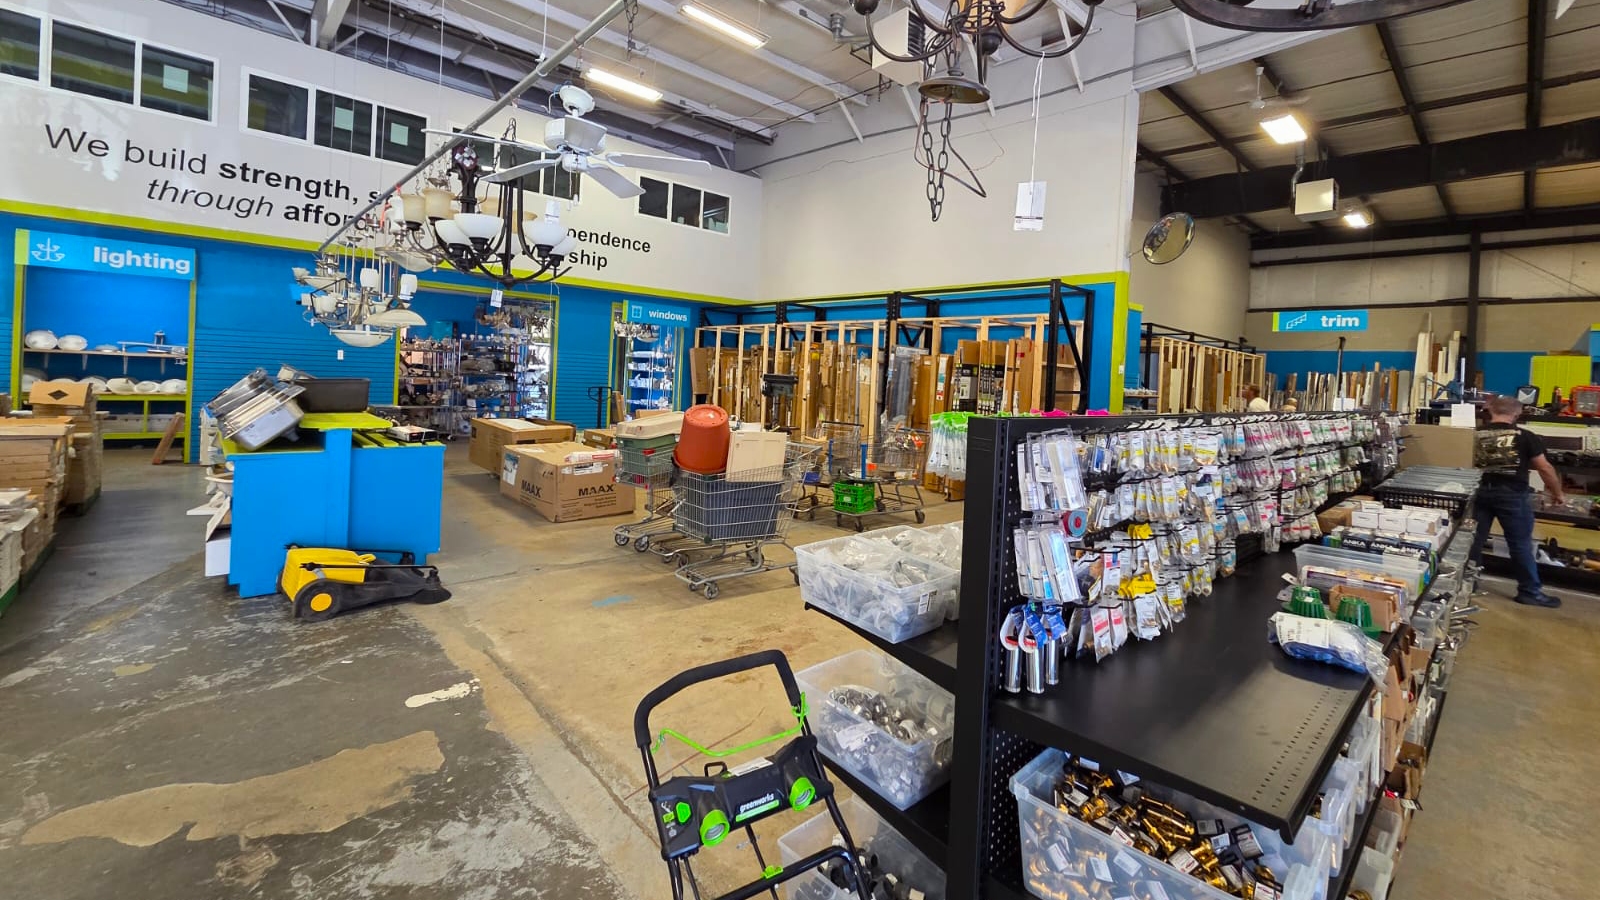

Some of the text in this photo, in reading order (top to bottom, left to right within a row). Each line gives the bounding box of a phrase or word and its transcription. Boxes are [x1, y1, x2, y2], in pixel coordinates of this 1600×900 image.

[45, 124, 110, 157] We
[124, 139, 207, 175] build
[218, 161, 358, 205] strength,
[147, 178, 371, 231] through afford
[93, 246, 191, 275] lighting
[648, 309, 688, 322] windows
[1320, 314, 1360, 328] trim
[521, 480, 542, 498] MAAX
[578, 484, 615, 497] MAAX
[739, 793, 775, 814] greenworks
